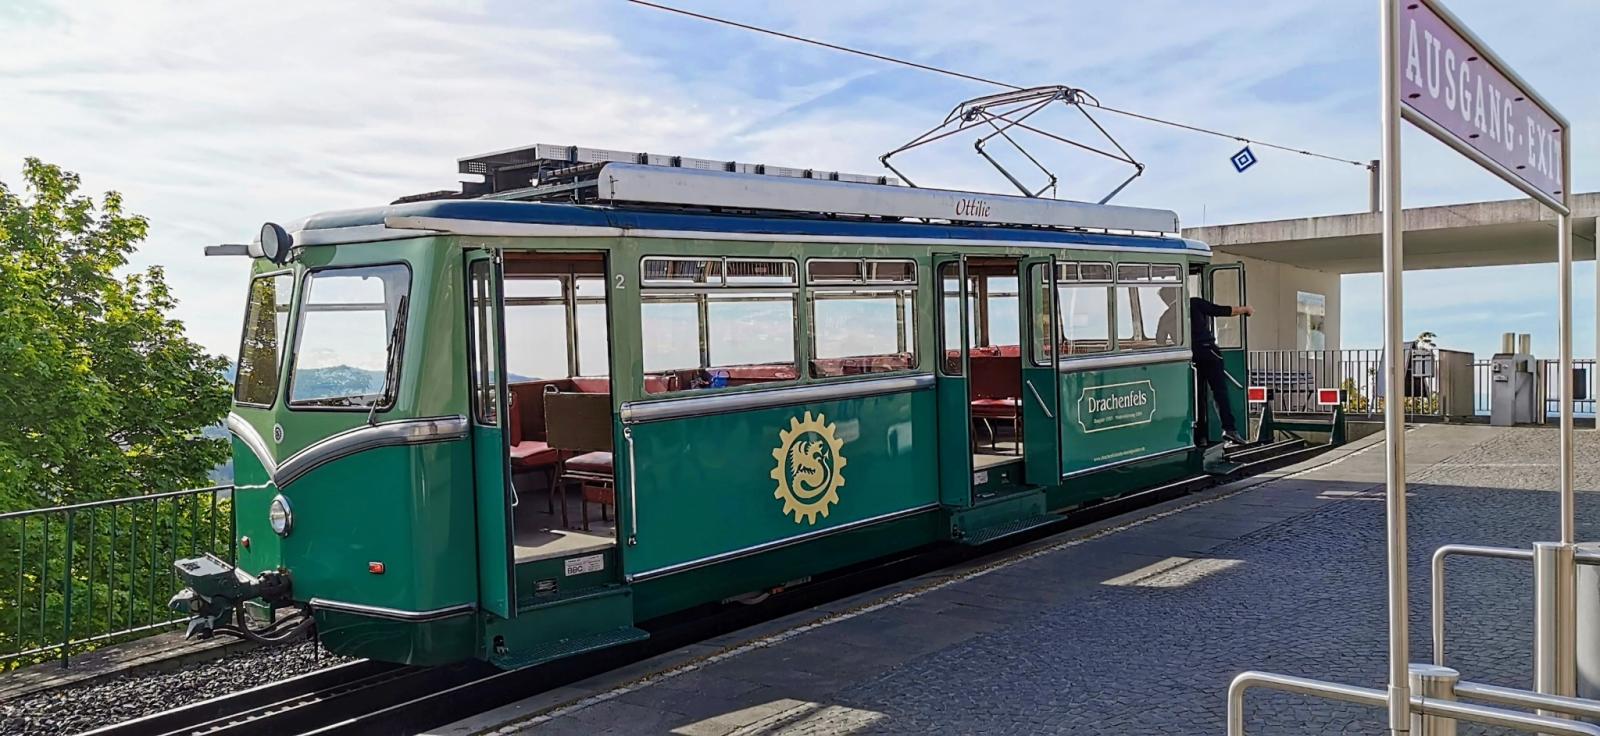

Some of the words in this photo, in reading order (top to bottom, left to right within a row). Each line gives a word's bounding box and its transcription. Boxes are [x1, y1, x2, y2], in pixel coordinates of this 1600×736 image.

[1405, 18, 1514, 152] AUSGANG
[1527, 115, 1561, 185] EXIT
[955, 198, 991, 217] Ottilie
[615, 274, 625, 289] 2
[1088, 390, 1147, 413] Drachenfels
